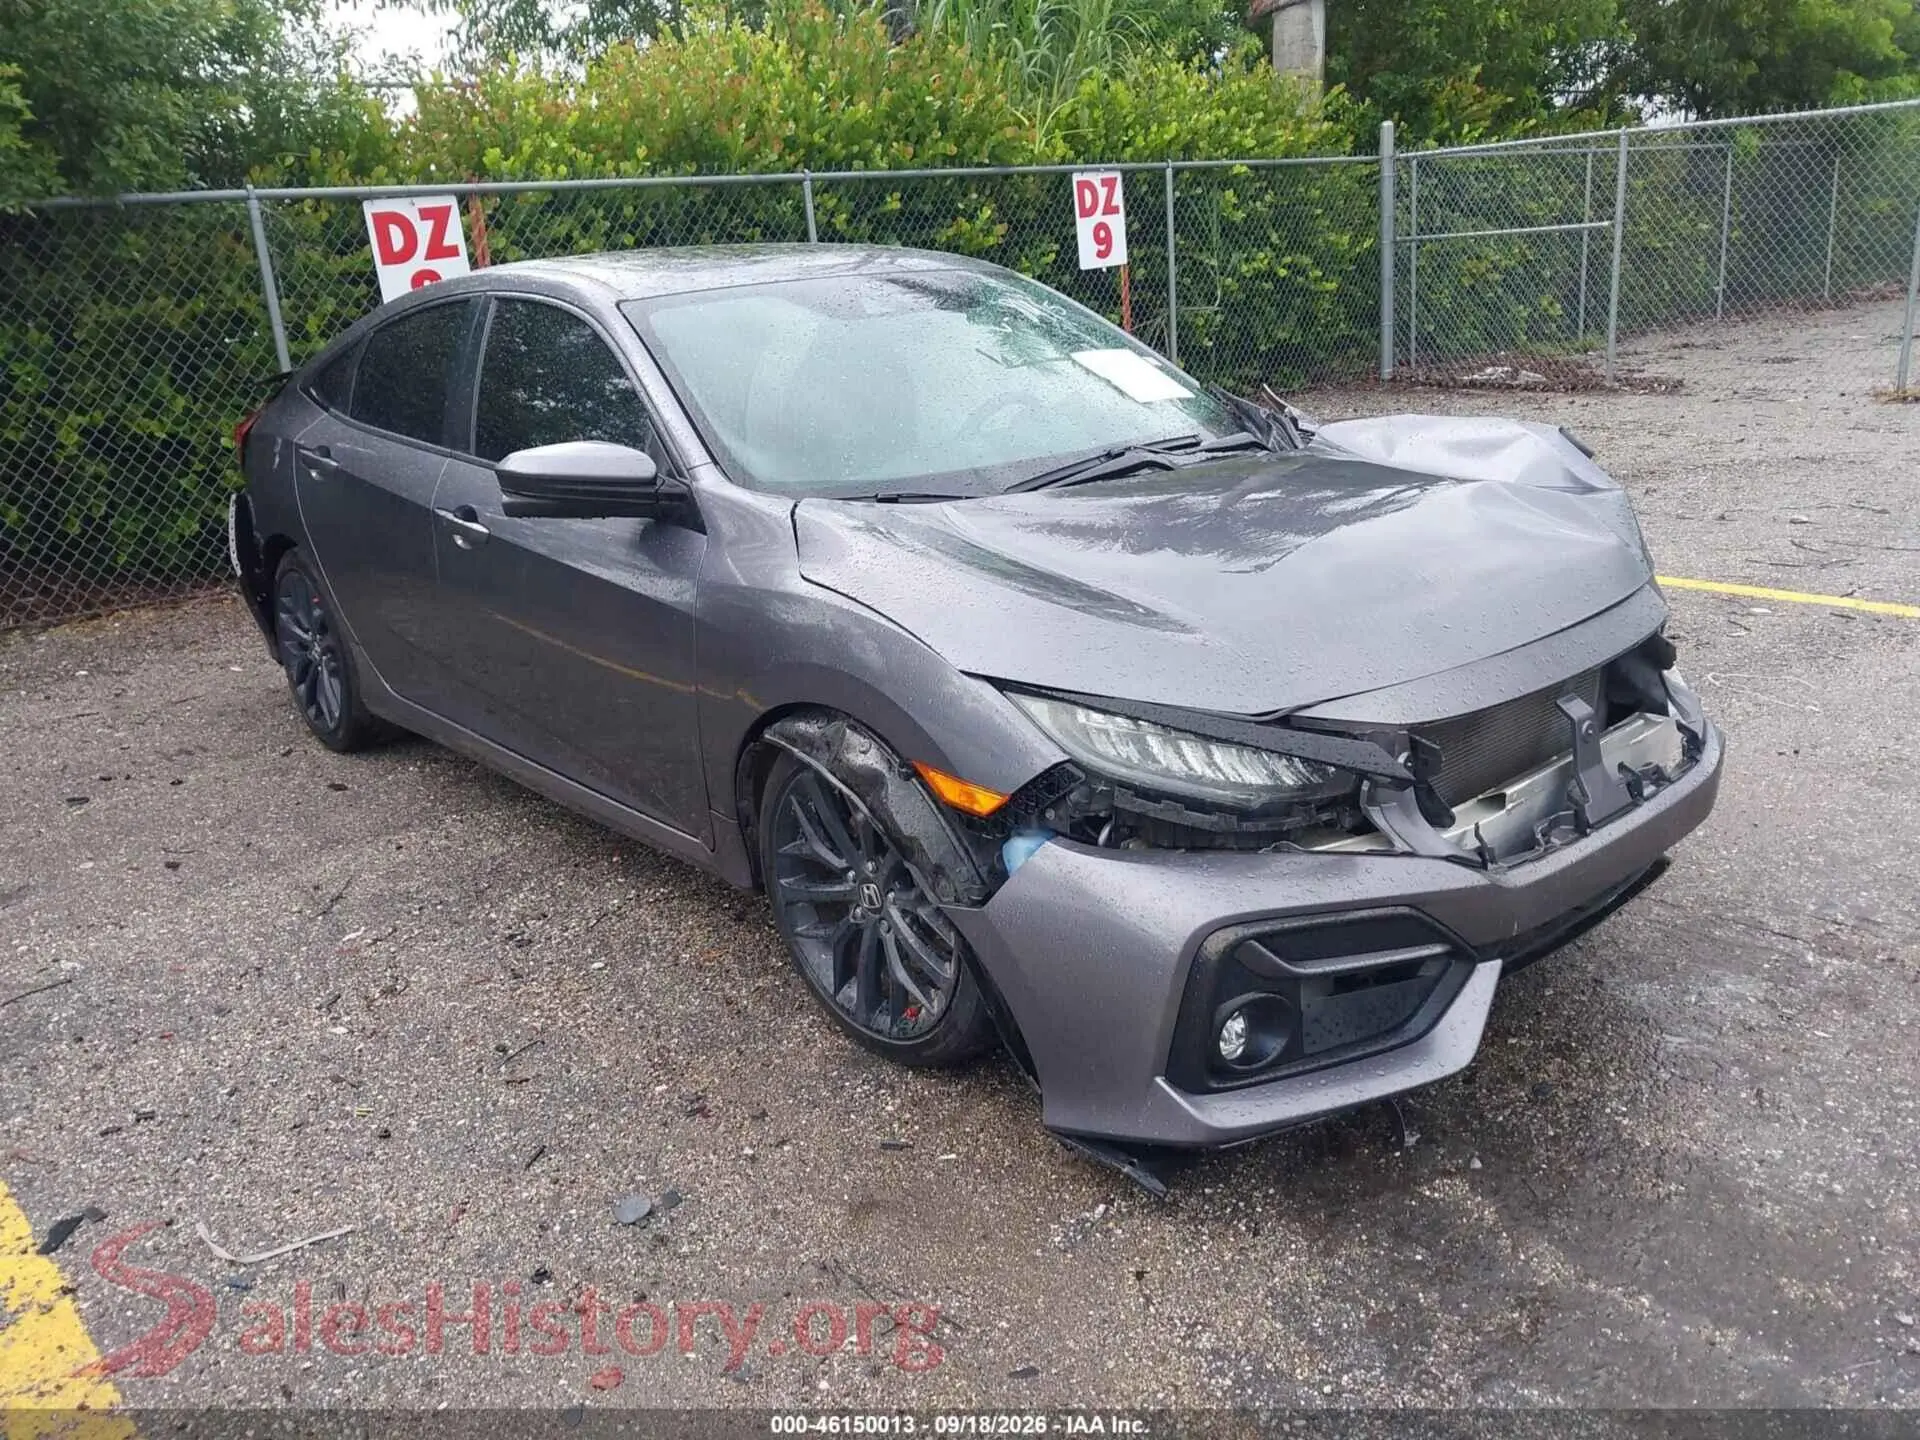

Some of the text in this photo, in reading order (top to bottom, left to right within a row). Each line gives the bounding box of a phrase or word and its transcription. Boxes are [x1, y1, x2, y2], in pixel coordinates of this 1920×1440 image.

[1076, 177, 1120, 218] DZ
[371, 205, 460, 265] DZ
[1093, 221, 1112, 259] 9
